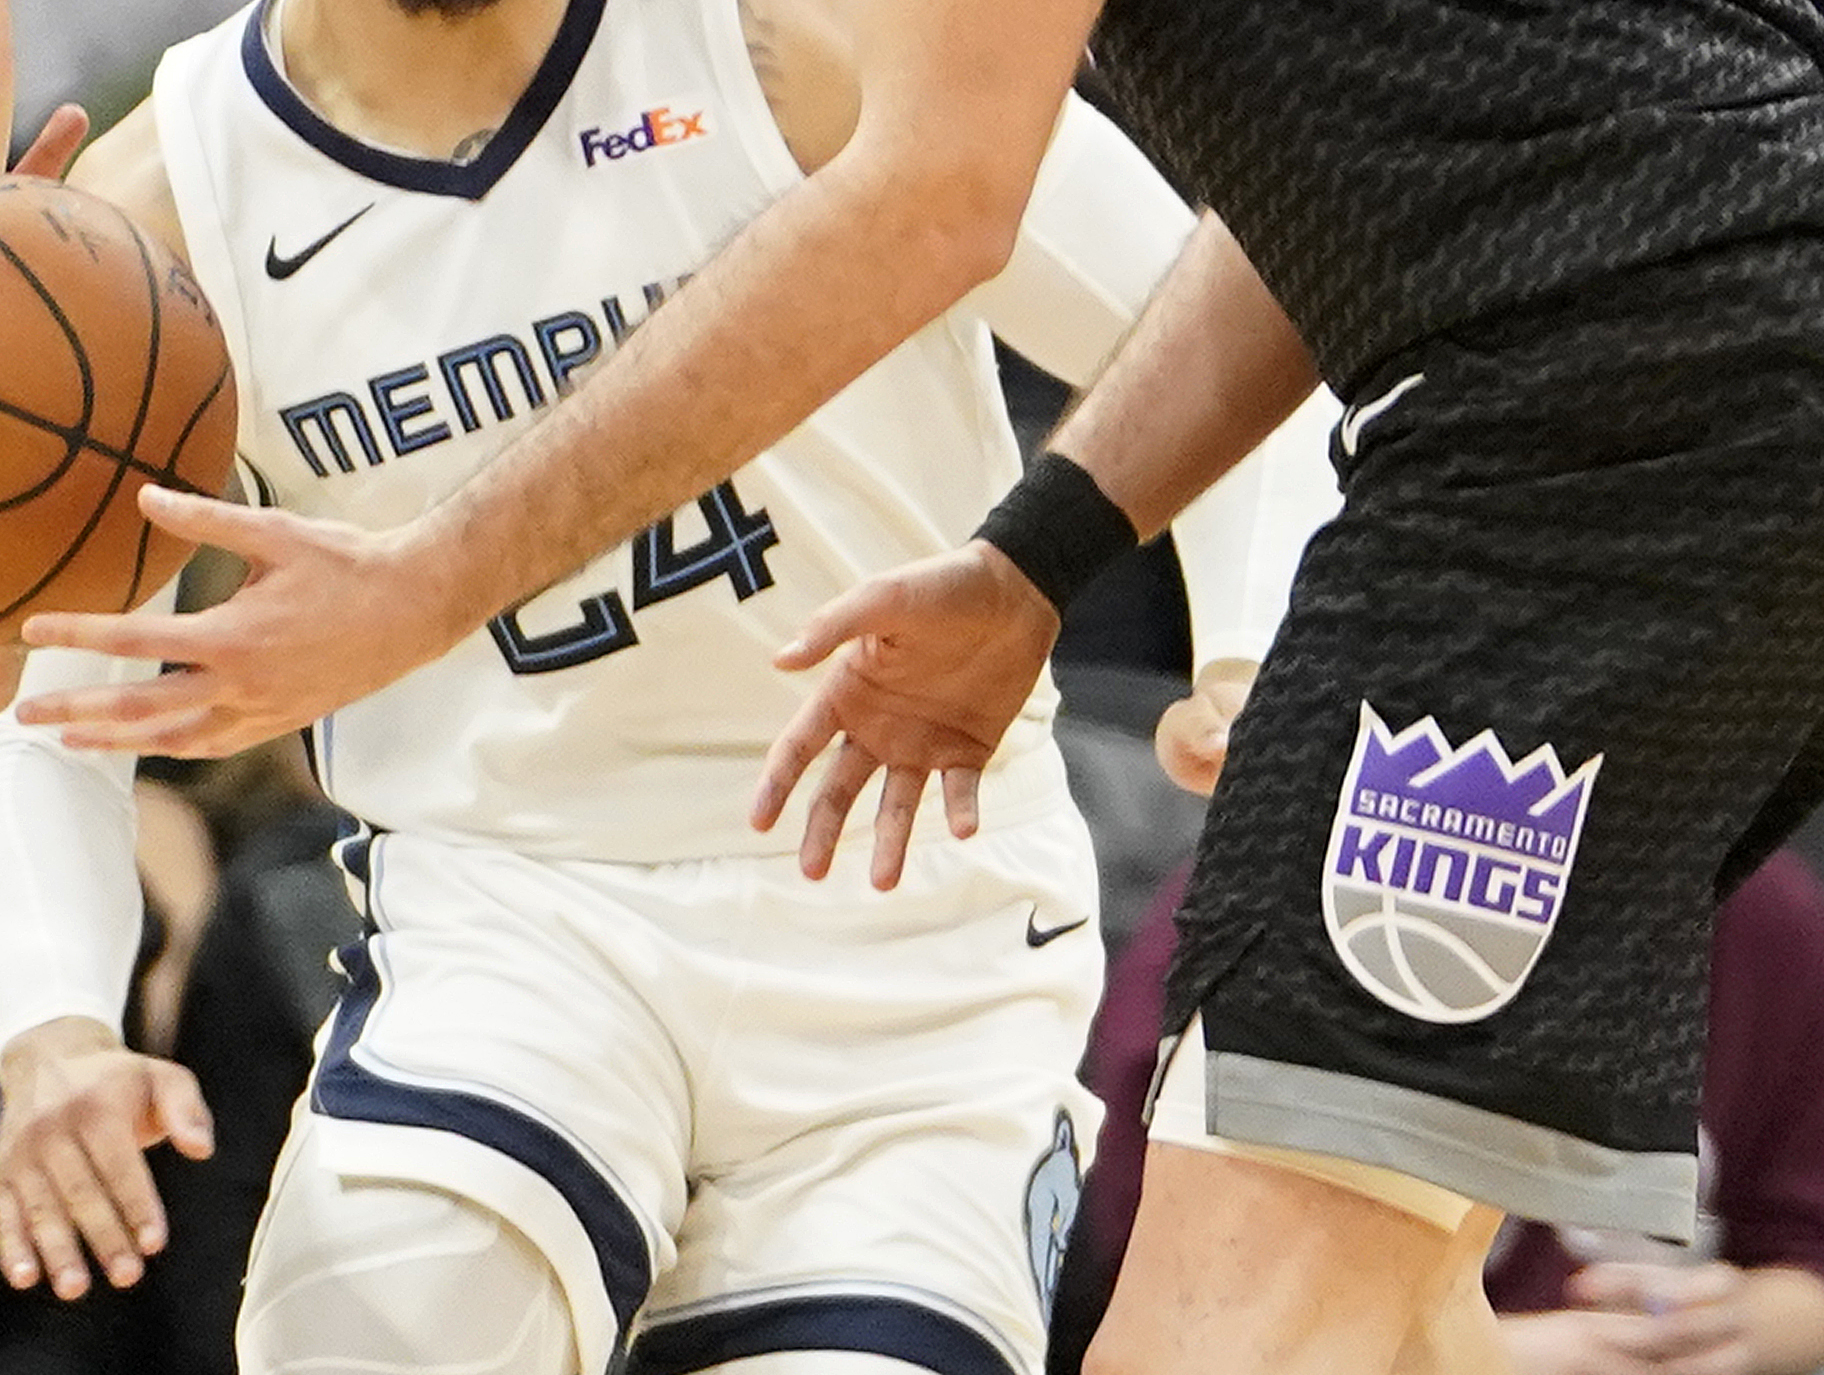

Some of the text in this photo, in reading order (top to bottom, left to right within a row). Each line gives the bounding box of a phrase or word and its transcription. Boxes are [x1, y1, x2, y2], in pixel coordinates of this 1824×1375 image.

[580, 107, 707, 168] FedEx
[1357, 788, 1567, 860] SACRAMENTO
[1336, 824, 1561, 924] KINGS
